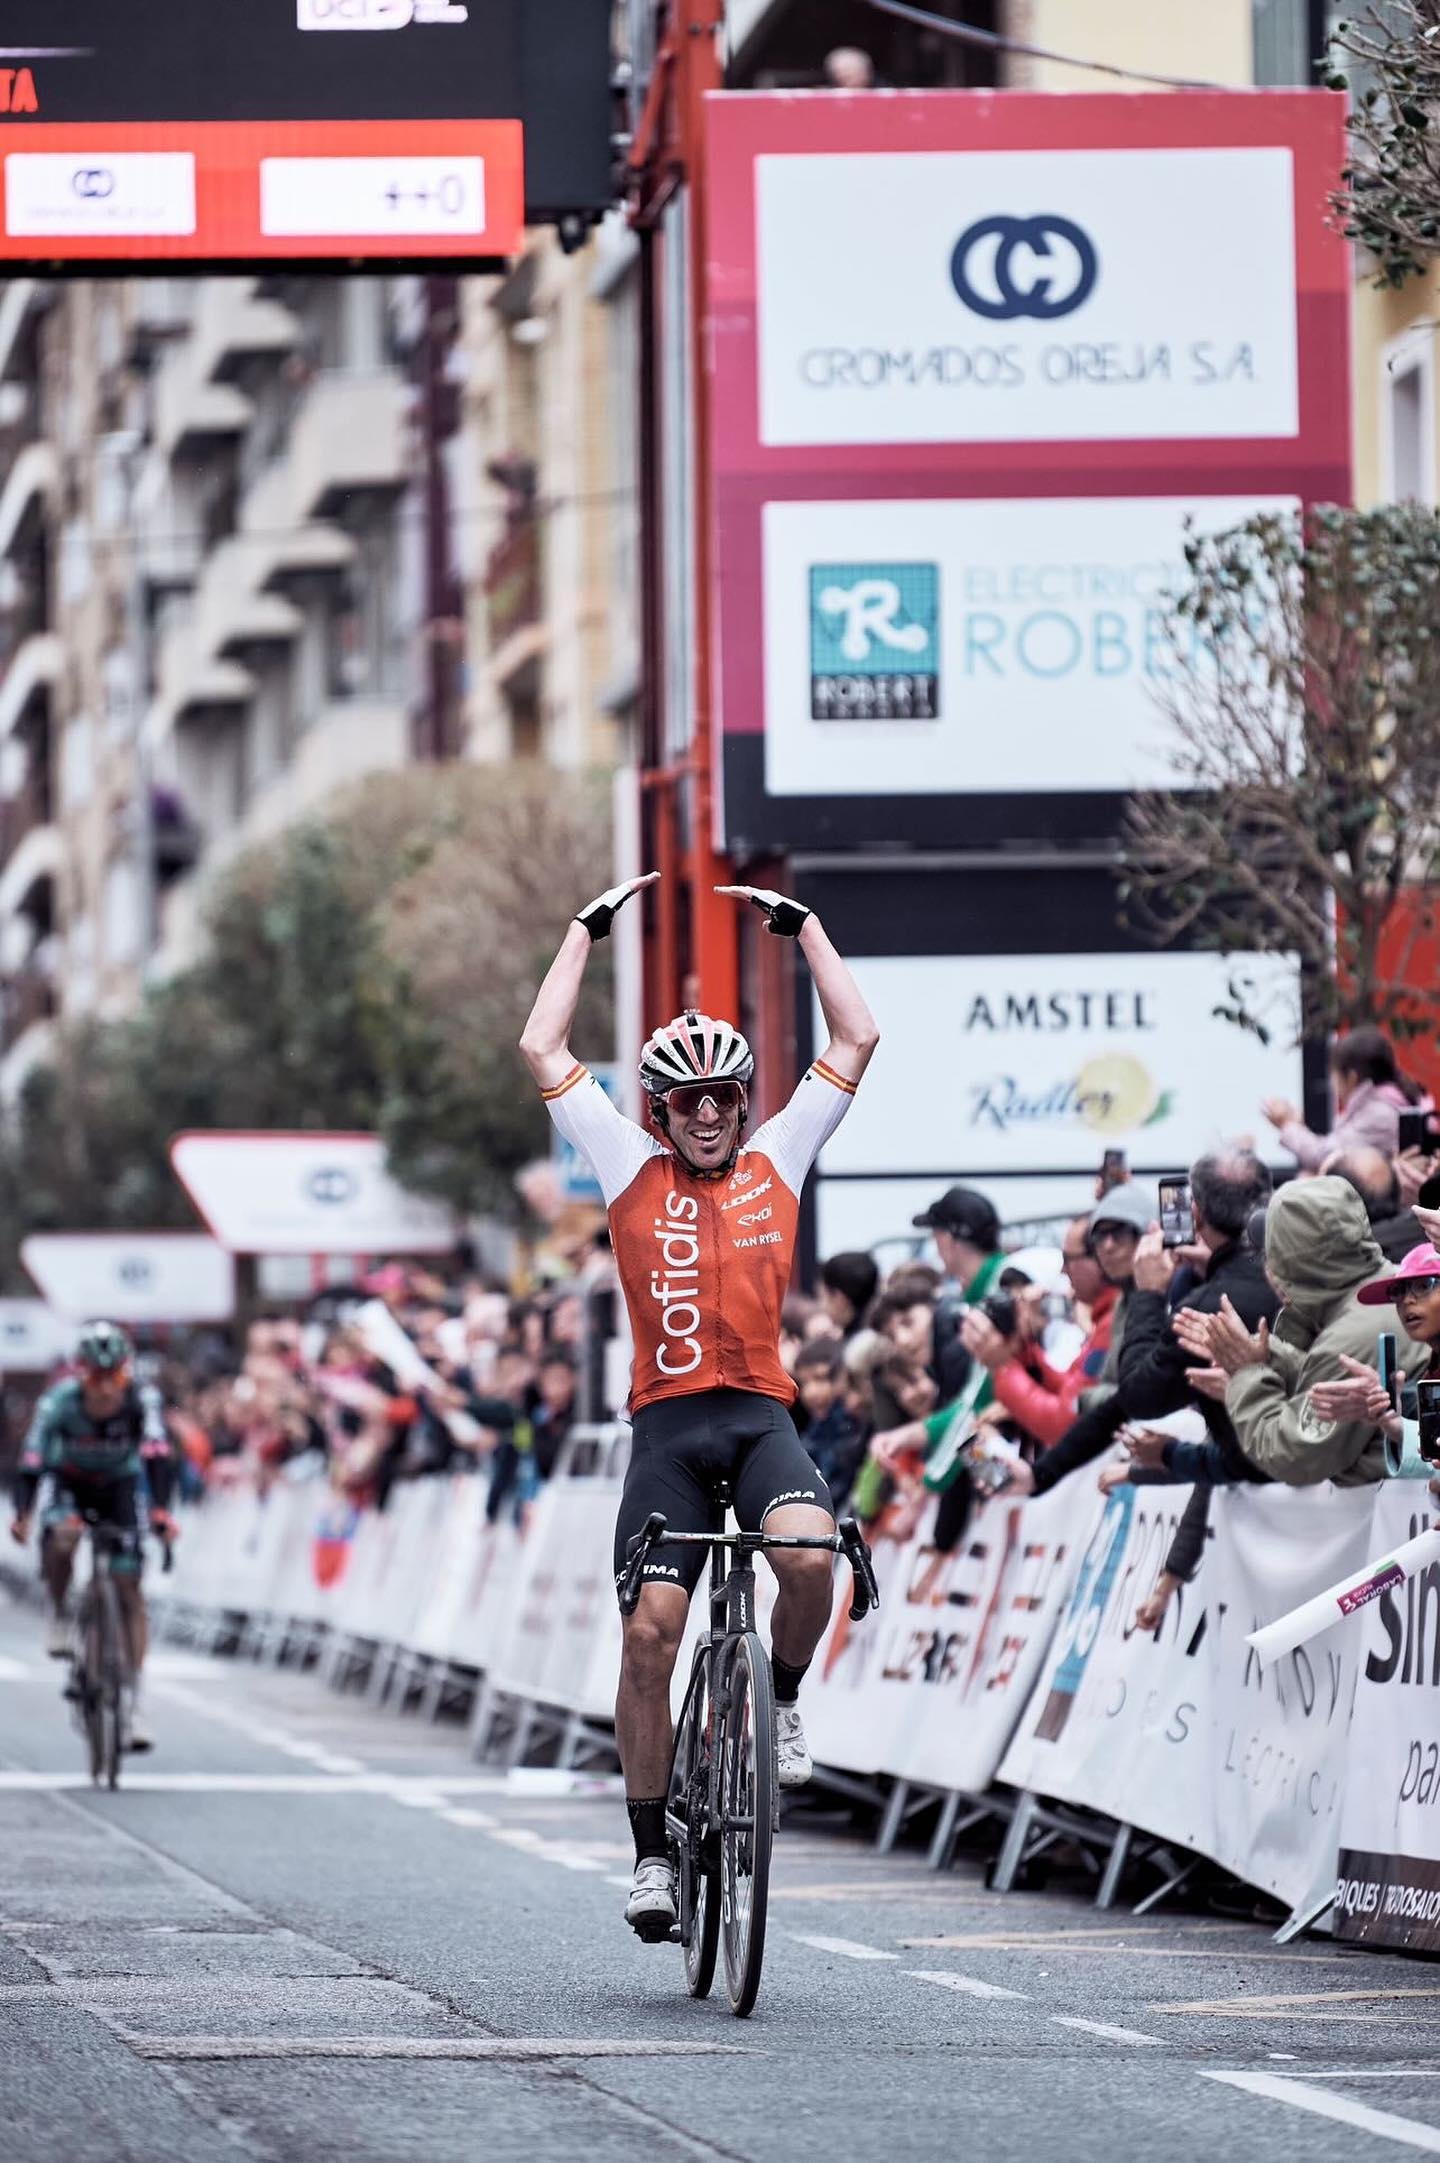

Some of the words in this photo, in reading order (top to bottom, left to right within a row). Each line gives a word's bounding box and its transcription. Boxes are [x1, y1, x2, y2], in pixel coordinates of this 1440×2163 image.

[801, 345, 1026, 388] CROMADOS
[1041, 341, 1172, 381] OREJA
[964, 989, 1158, 1031] AMSTEL
[721, 1175, 773, 1211] LOOK
[733, 1237, 758, 1248] VAN
[760, 1231, 783, 1245] RYSEL
[652, 1190, 701, 1375] Cofidis
